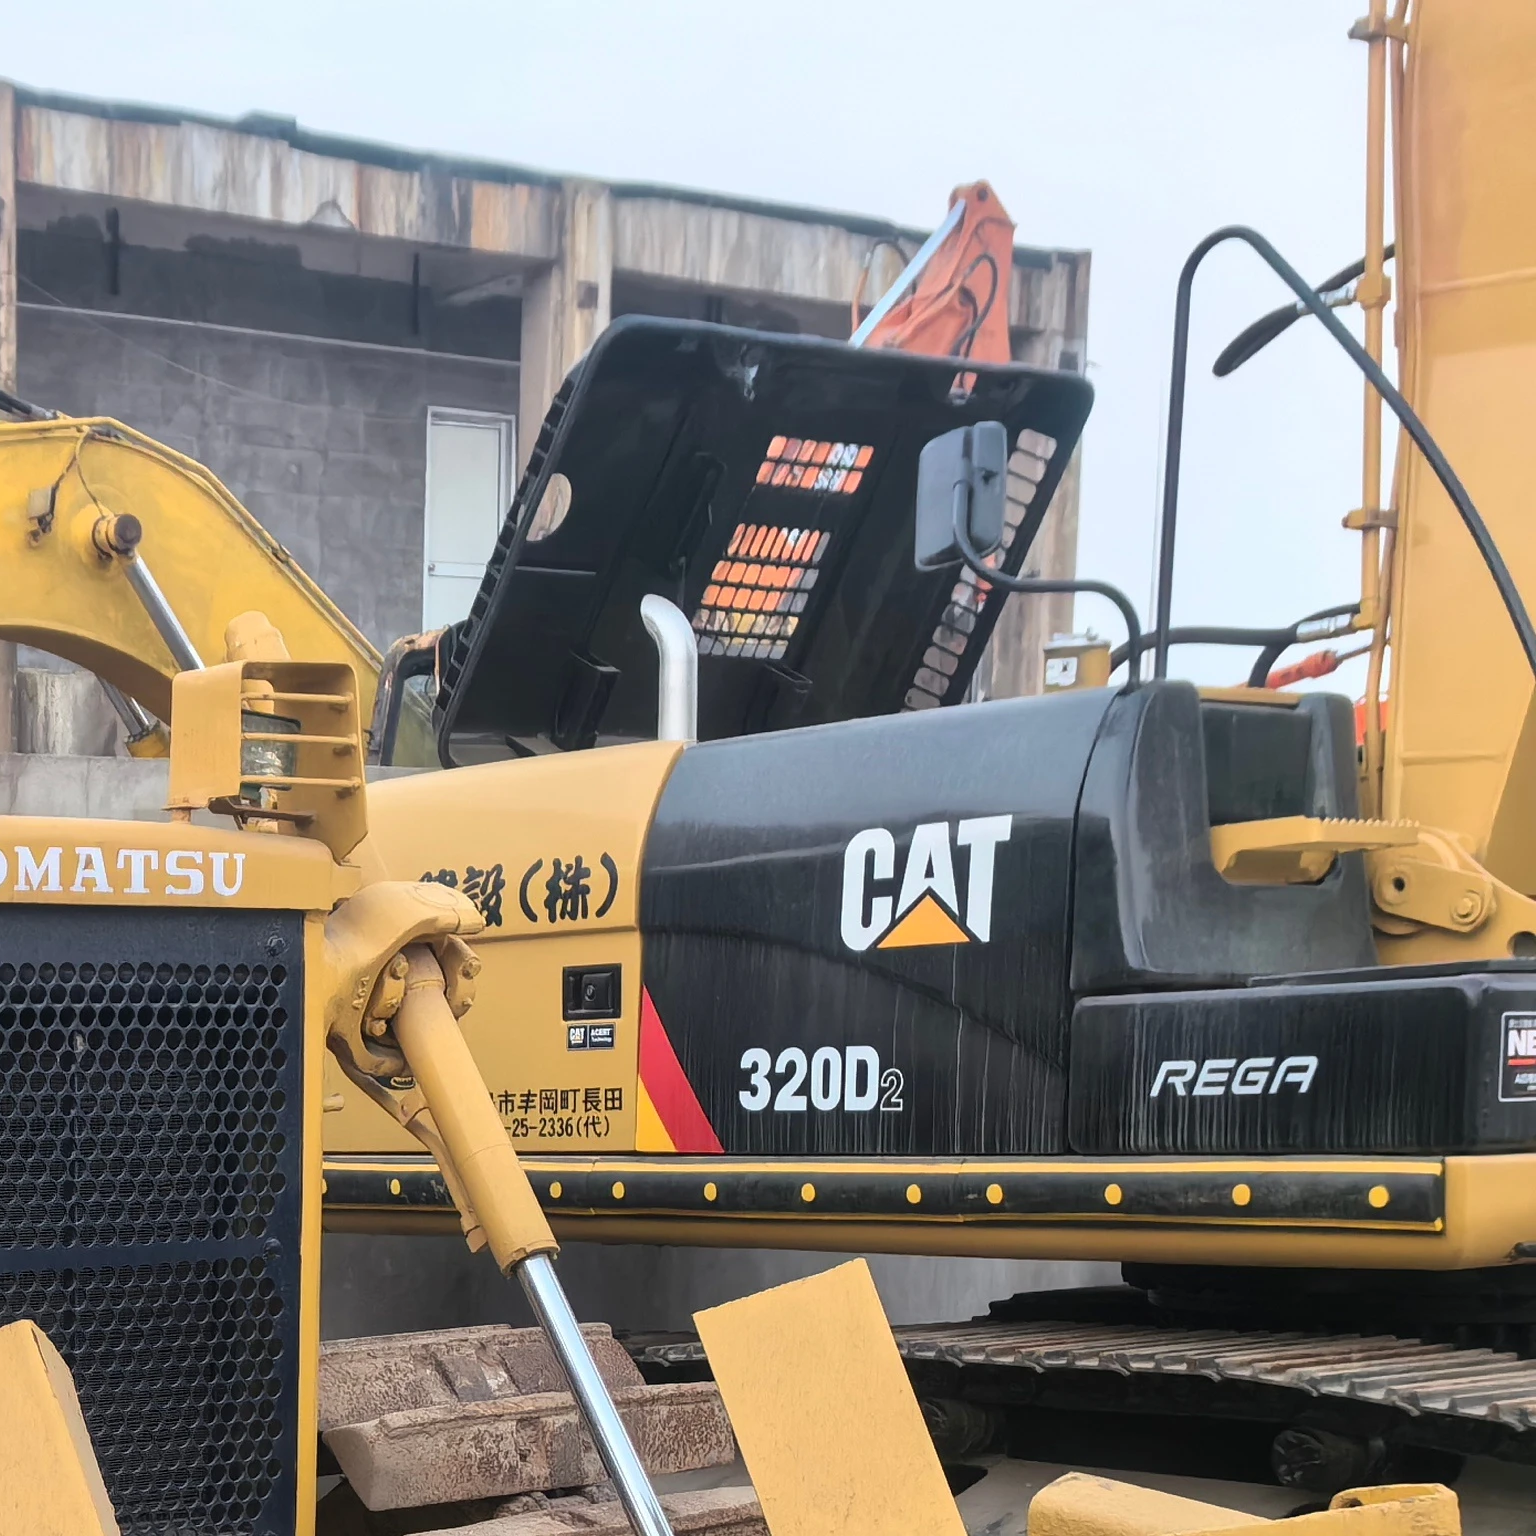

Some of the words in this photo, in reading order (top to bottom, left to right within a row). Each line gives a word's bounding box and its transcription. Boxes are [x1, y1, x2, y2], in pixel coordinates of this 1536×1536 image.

[840, 814, 1013, 952] CAT
[569, 1027, 585, 1041] CAT
[738, 1045, 904, 1112] 320D2
[1149, 1055, 1319, 1098] REGA
